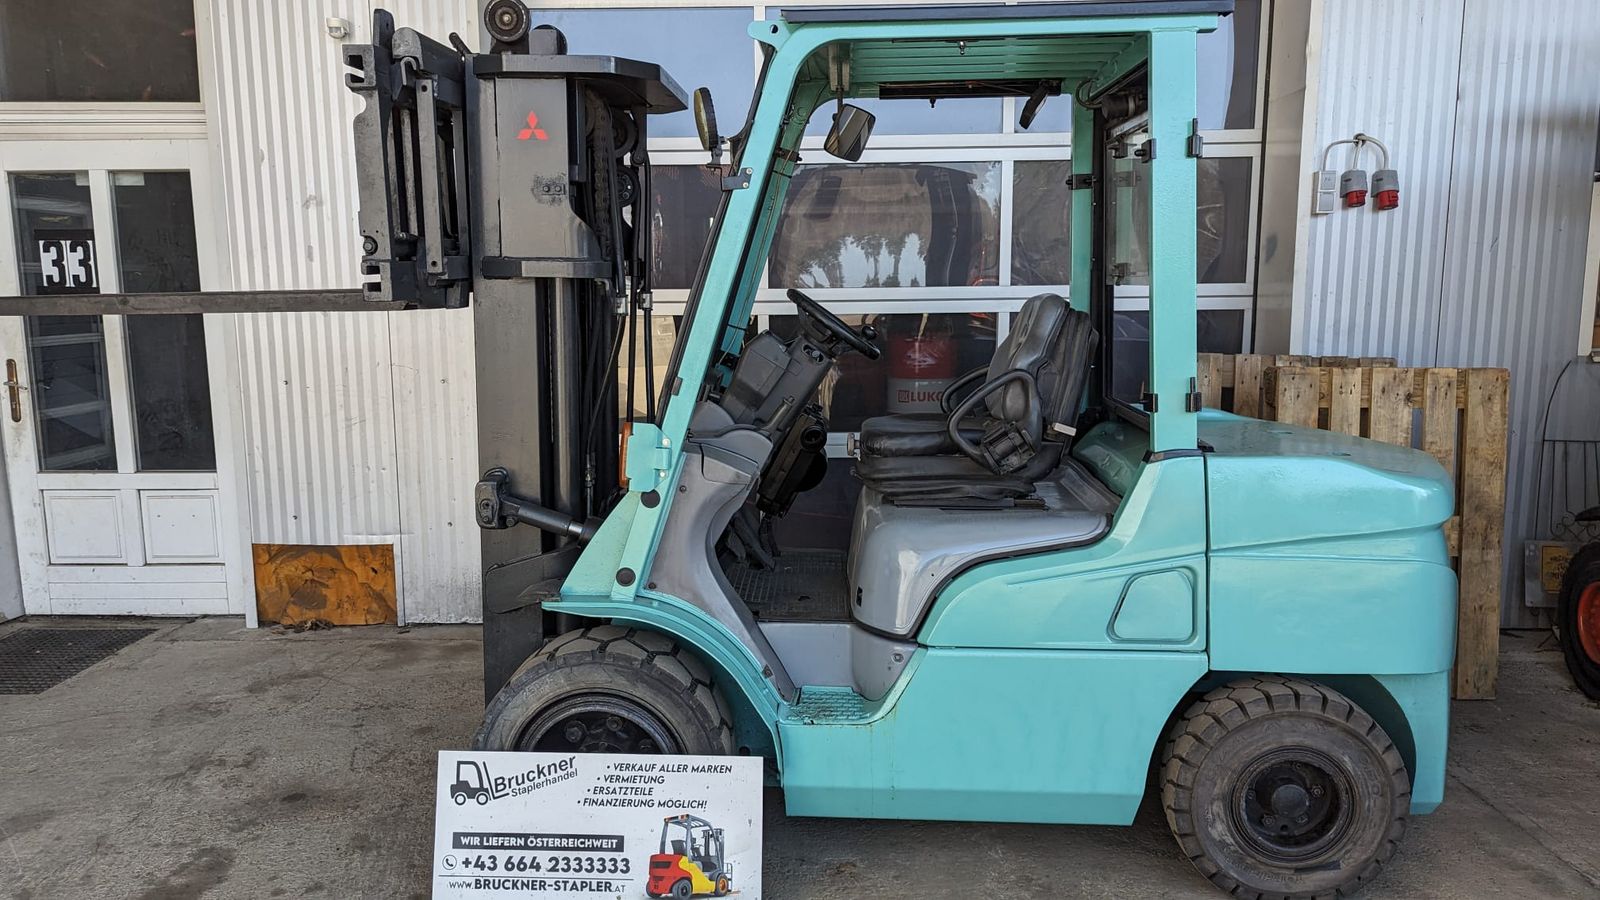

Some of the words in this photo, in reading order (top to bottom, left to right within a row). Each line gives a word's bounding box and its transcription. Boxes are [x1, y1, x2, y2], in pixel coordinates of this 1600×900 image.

[42, 240, 95, 288] 33
[493, 756, 576, 793] Bruckner
[613, 763, 657, 773] VERKAUF
[659, 764, 689, 773] ALLER
[690, 765, 733, 774] MARKEN
[511, 768, 578, 797] Staplerhandel
[603, 775, 665, 784] VERMIETUNG
[593, 786, 654, 796] ERSATZTEILE
[582, 798, 655, 808] FINANZIERUNG
[657, 797, 708, 809] MÖGLICH!
[460, 836, 480, 846] WIR
[483, 837, 525, 847] LIEFERN
[527, 835, 618, 849] ÖSTERREICHWEIT
[461, 855, 498, 872] +43
[504, 855, 542, 872] 664
[547, 856, 631, 874] 2333333
